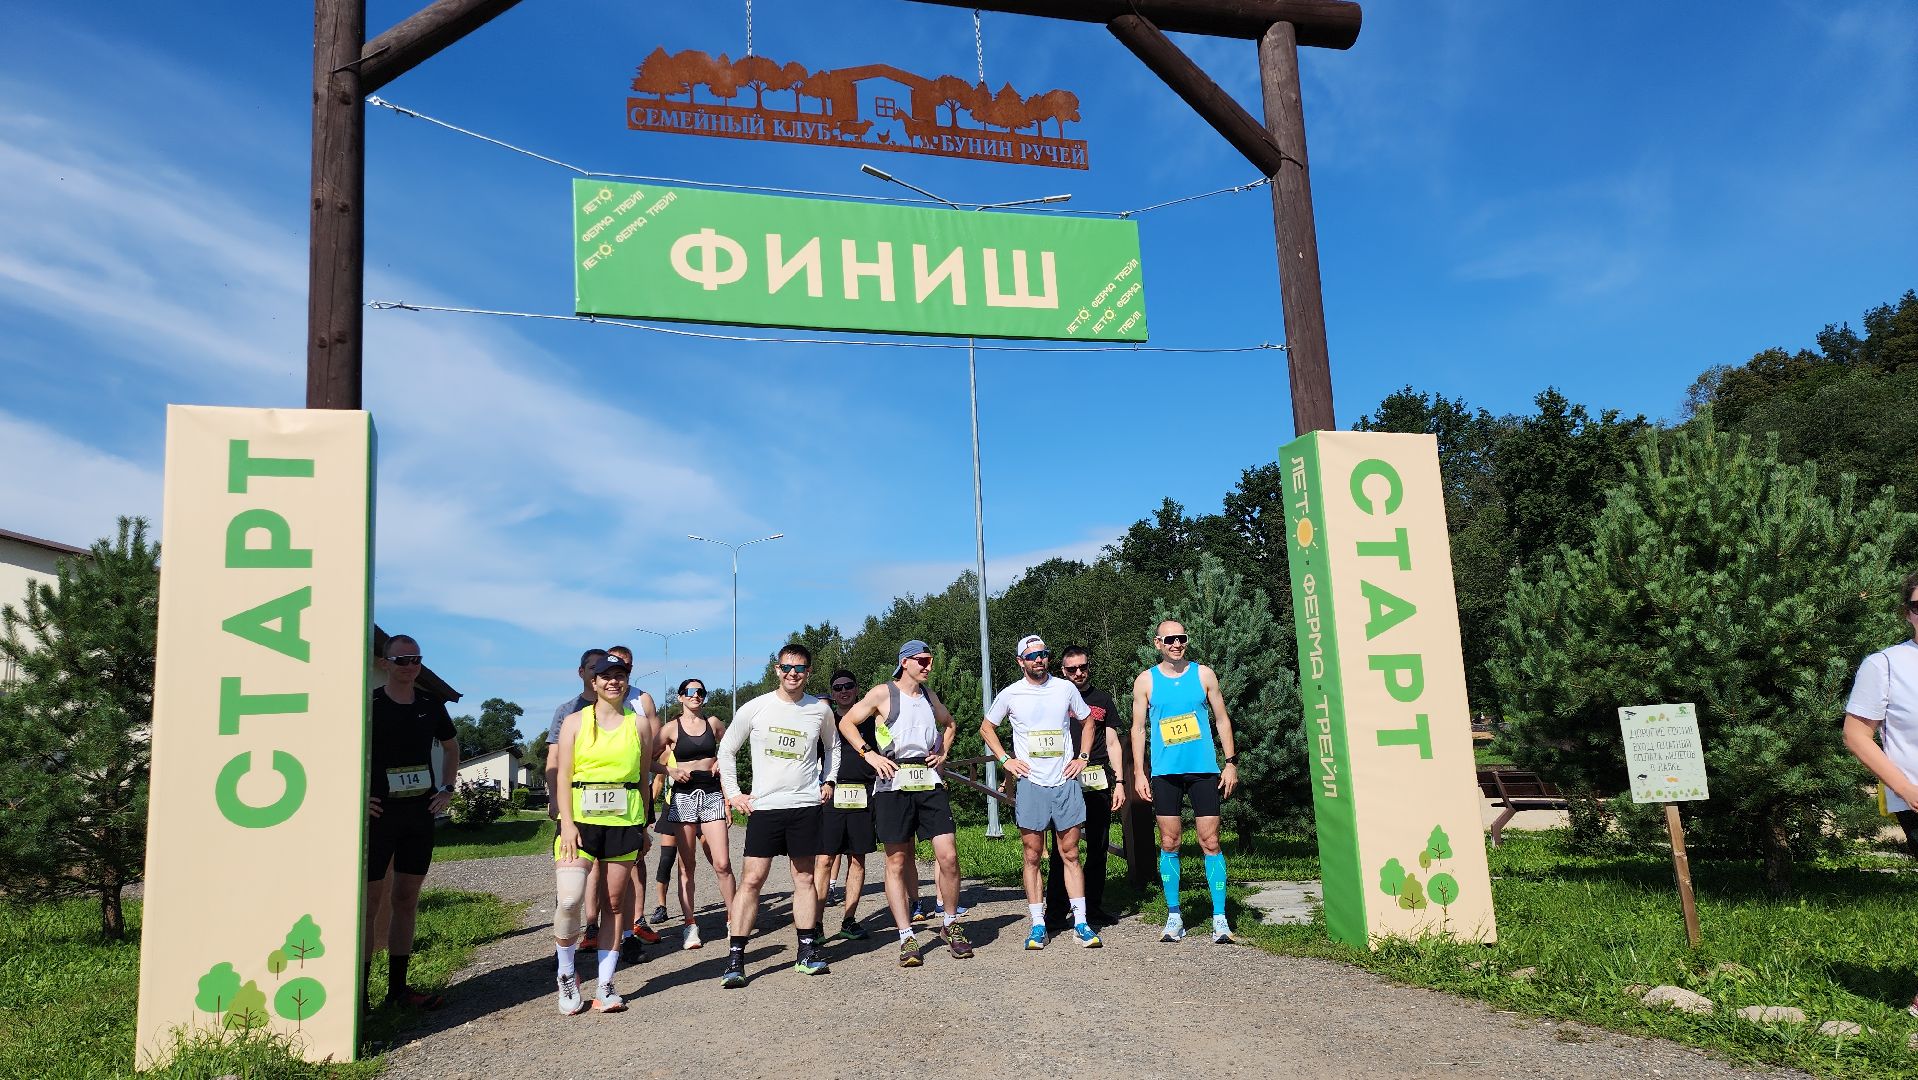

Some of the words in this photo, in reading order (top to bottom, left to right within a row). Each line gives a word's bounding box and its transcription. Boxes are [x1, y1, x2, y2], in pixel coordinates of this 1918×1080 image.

[630, 106, 766, 135] СЕМЕЙНЫЙ
[773, 118, 830, 141] КЛУБ
[939, 134, 1014, 159] БУНИН
[1020, 143, 1087, 166] РУЧЕЙ
[583, 215, 615, 242] ФЕРМА
[613, 190, 645, 215] ТРЕЙЛ
[615, 216, 648, 243] ФЕРМА
[645, 191, 678, 217] ТРЕЙЛ
[670, 228, 1060, 310] ФИНИШ
[1091, 282, 1117, 308] ФЕРМА
[1114, 258, 1139, 282] ТРЕЙЛ
[1116, 282, 1142, 308] ФЕРМА
[1117, 310, 1142, 335] ТРЕЙЛ
[1349, 458, 1434, 760] СТАРТ
[215, 439, 315, 829] СТАРТ
[1302, 573, 1325, 680] ФЕРМА
[1315, 694, 1338, 799] ТРЕЙЛ
[778, 735, 796, 748] 108
[1038, 736, 1054, 747] 113
[1170, 723, 1189, 735] 121
[399, 773, 420, 786] 114
[594, 791, 616, 803] 112
[844, 789, 859, 799] 117
